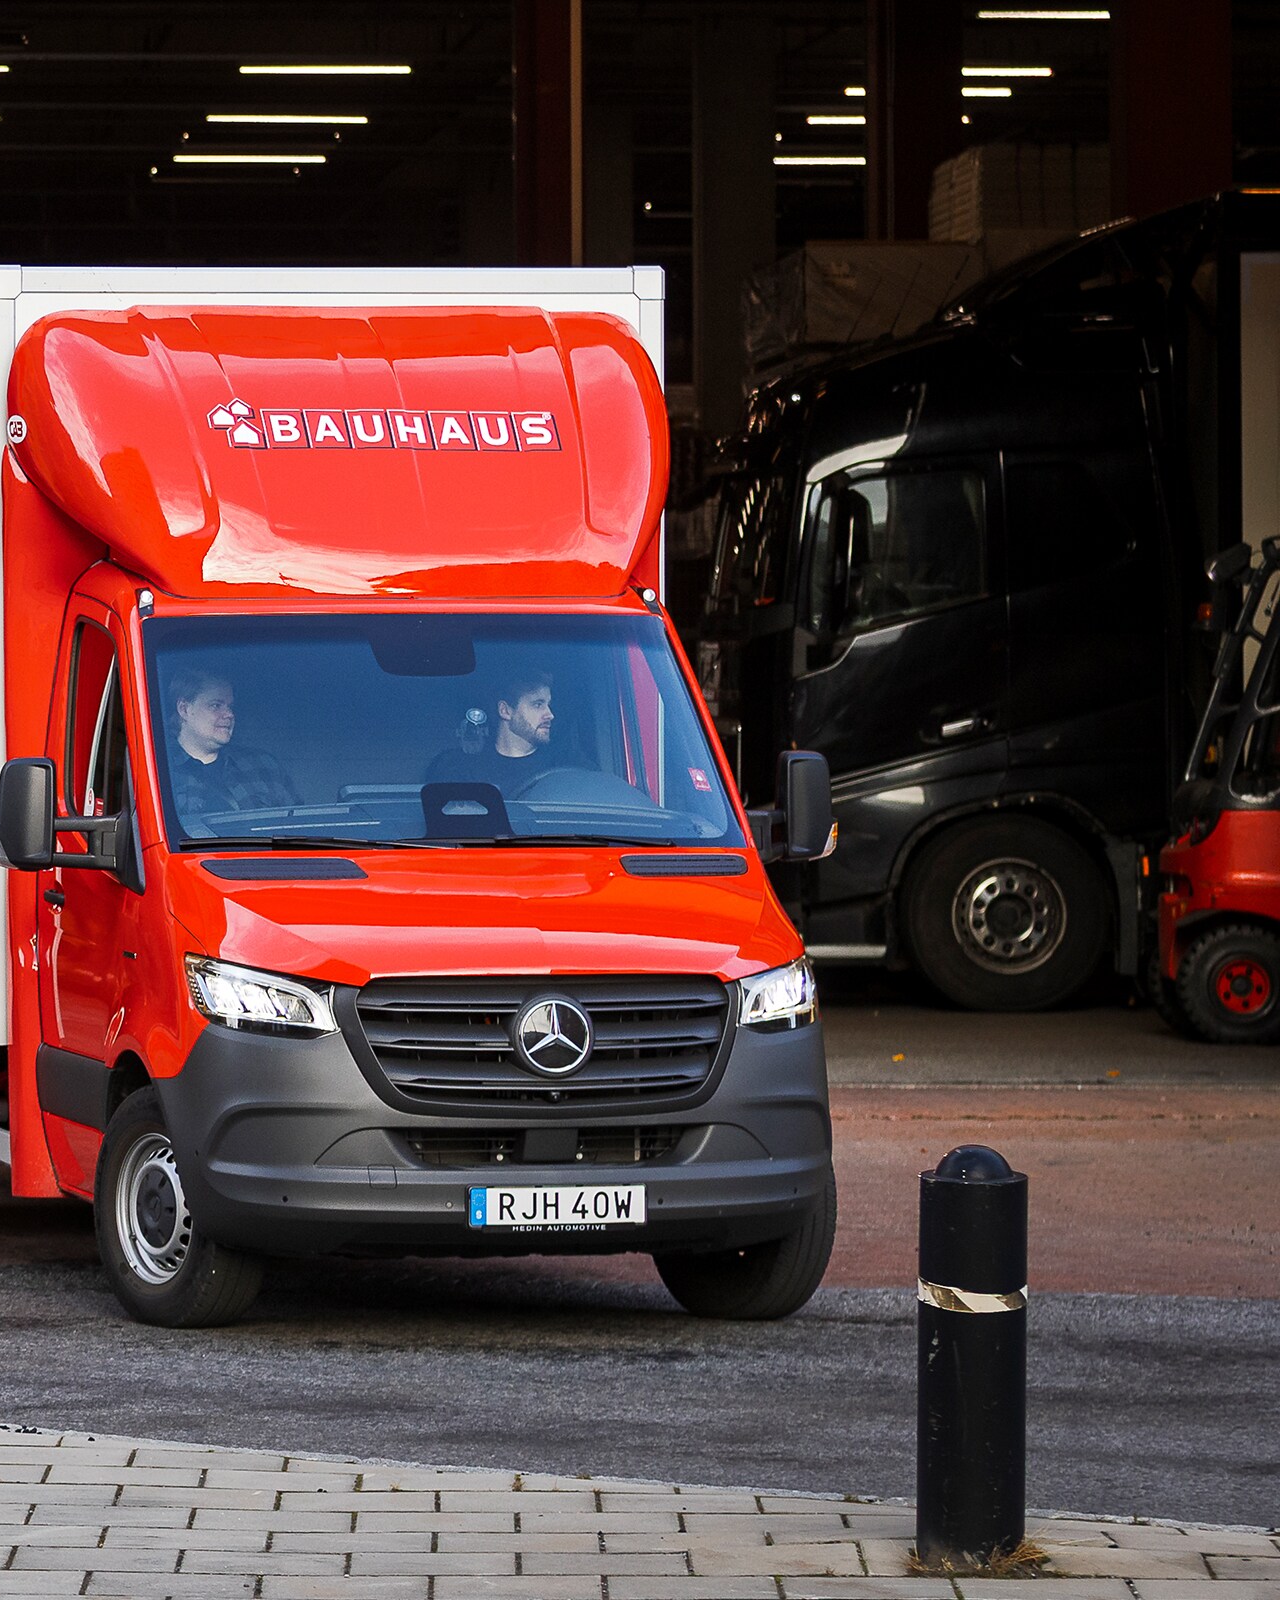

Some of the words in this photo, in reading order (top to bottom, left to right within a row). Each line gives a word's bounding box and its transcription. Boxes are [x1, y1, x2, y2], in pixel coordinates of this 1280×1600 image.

[269, 414, 552, 445] BAUHAUS
[499, 1192, 559, 1220] RJH
[572, 1191, 632, 1219] 40W
[547, 1224, 607, 1232] AUTOMOTIVE
